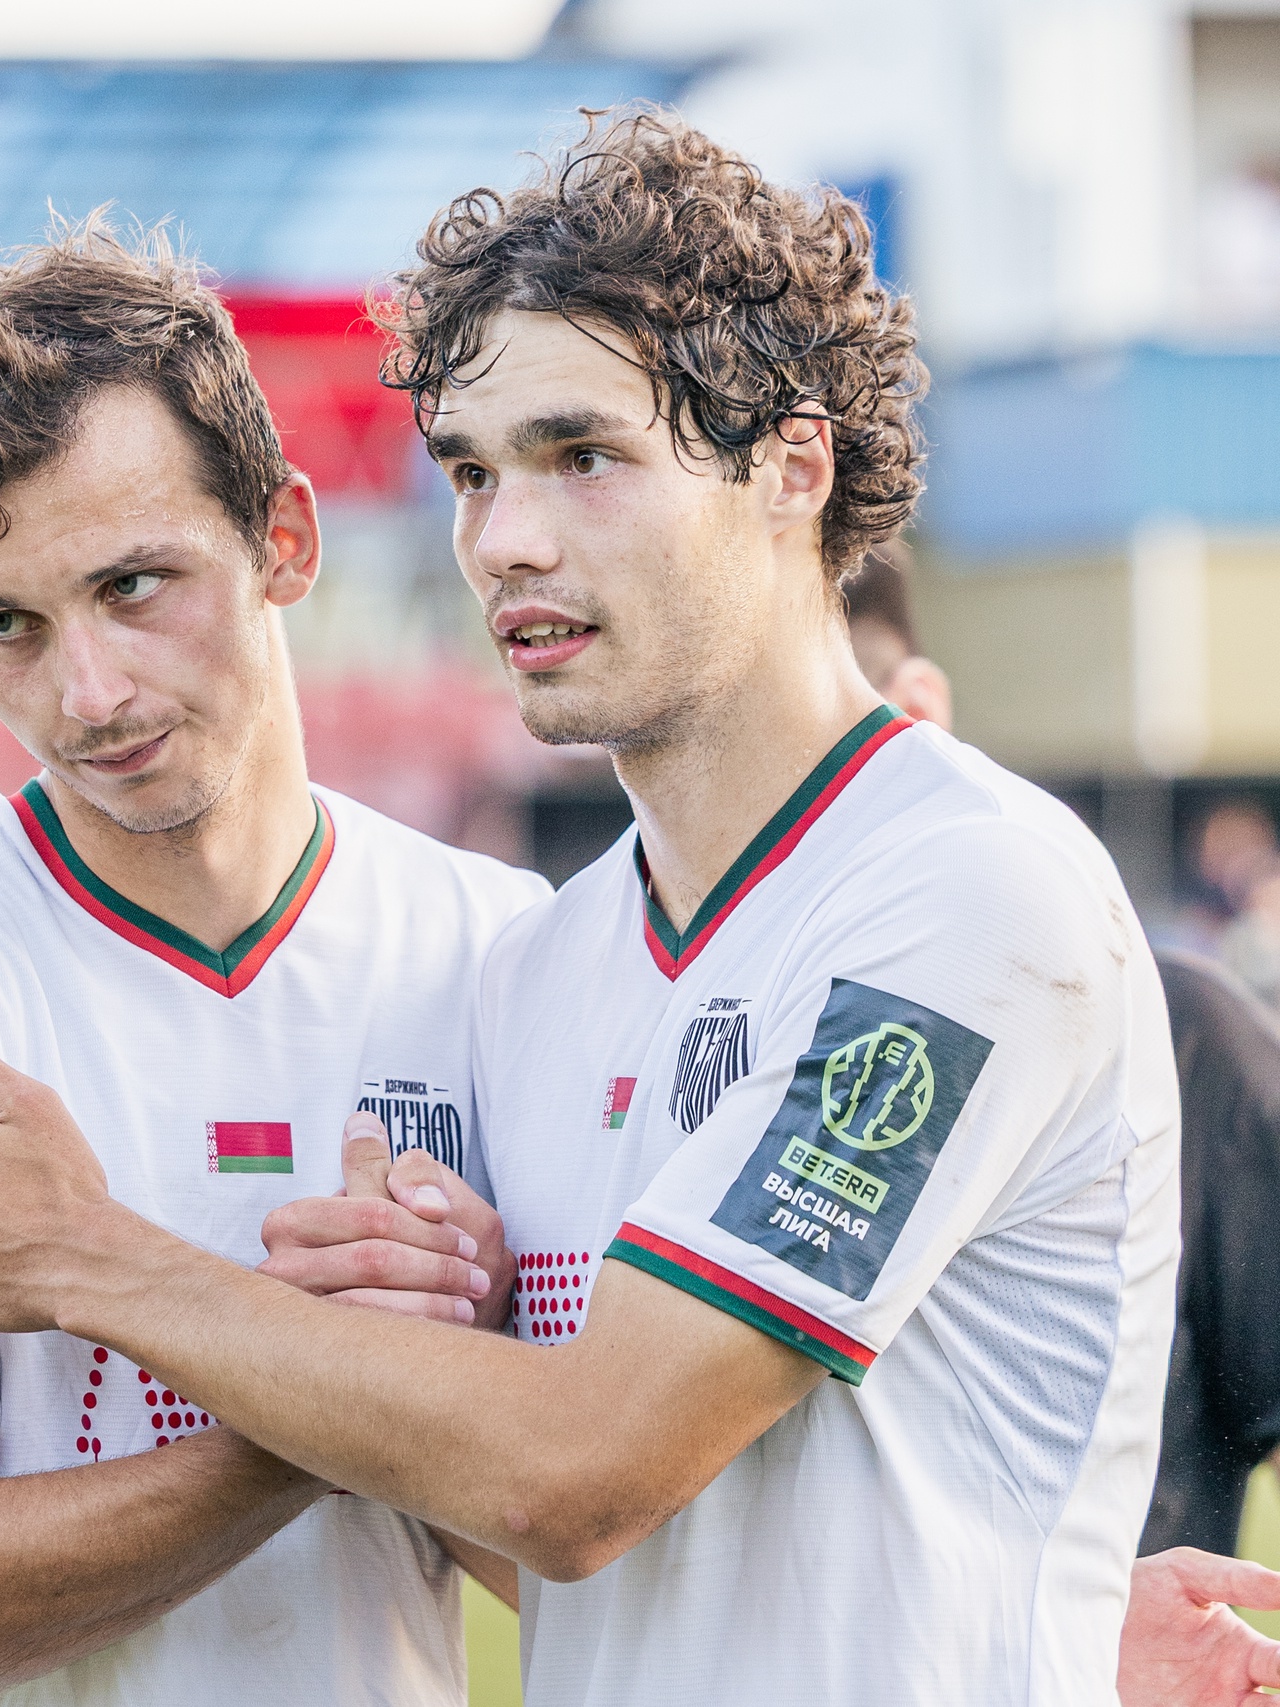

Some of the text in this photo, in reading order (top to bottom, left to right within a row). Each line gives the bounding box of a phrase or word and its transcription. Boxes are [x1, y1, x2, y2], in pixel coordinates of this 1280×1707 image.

[385, 1079, 428, 1095] ДЗЕРЖИНСК
[357, 1097, 464, 1179] СЕНАЛ
[762, 1171, 871, 1241] ВЫСШАЯ
[769, 1207, 831, 1253] ЛИГА
